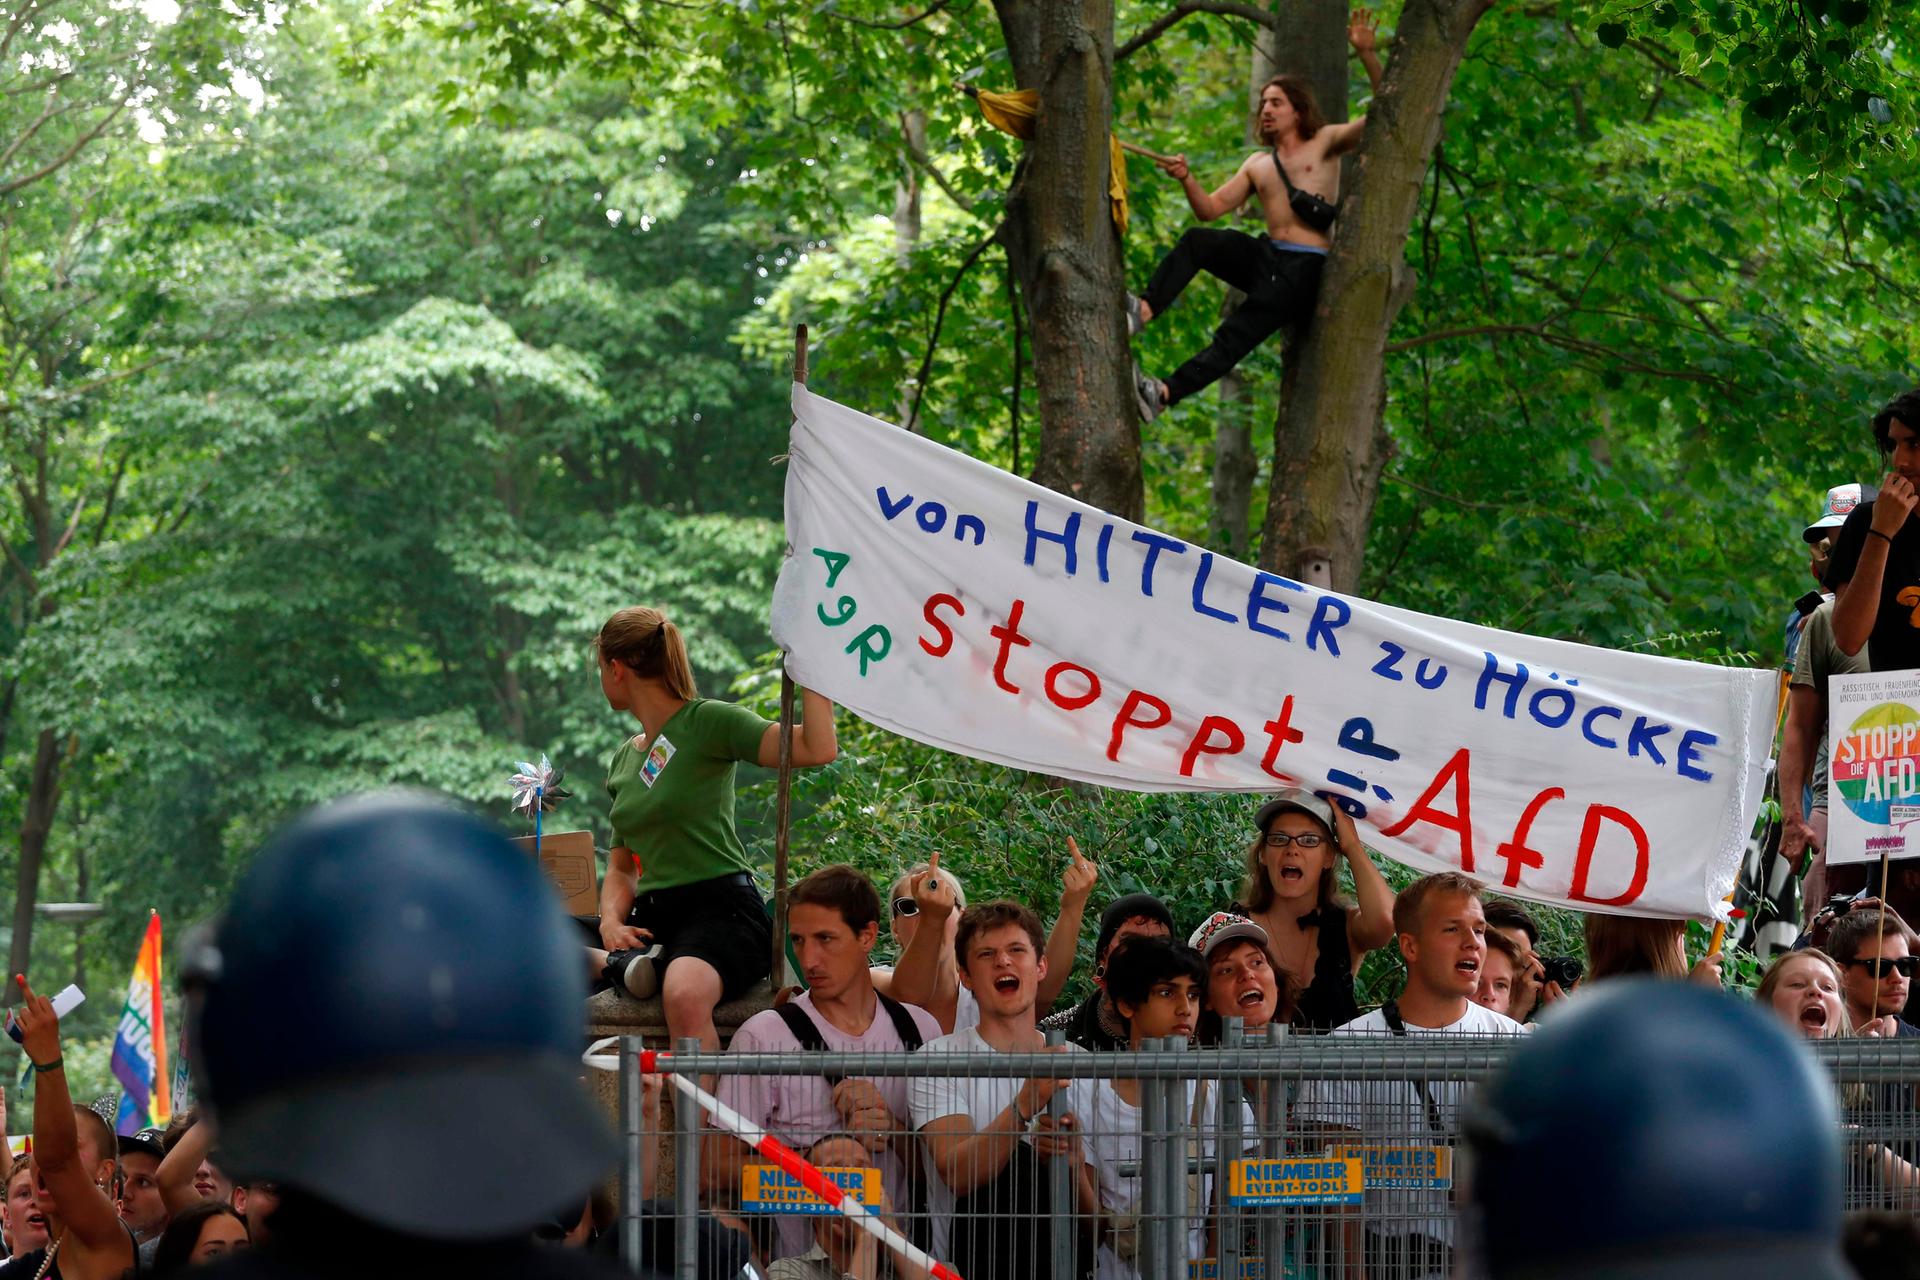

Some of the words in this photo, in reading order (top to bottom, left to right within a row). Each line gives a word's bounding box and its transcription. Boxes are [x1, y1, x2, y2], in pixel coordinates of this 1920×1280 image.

[876, 486, 986, 546] von
[1024, 500, 1352, 658] HITLER
[1371, 641, 1448, 690] zu
[1474, 651, 1719, 782] HÖCKE
[1841, 720, 1920, 764] STOPP
[1850, 762, 1864, 776] DIE
[1863, 757, 1915, 803] AFD
[1380, 748, 1650, 907] AfD
[1245, 1162, 1349, 1180] NIEMEIER
[1245, 1181, 1349, 1193] EVENT-TOOLS
